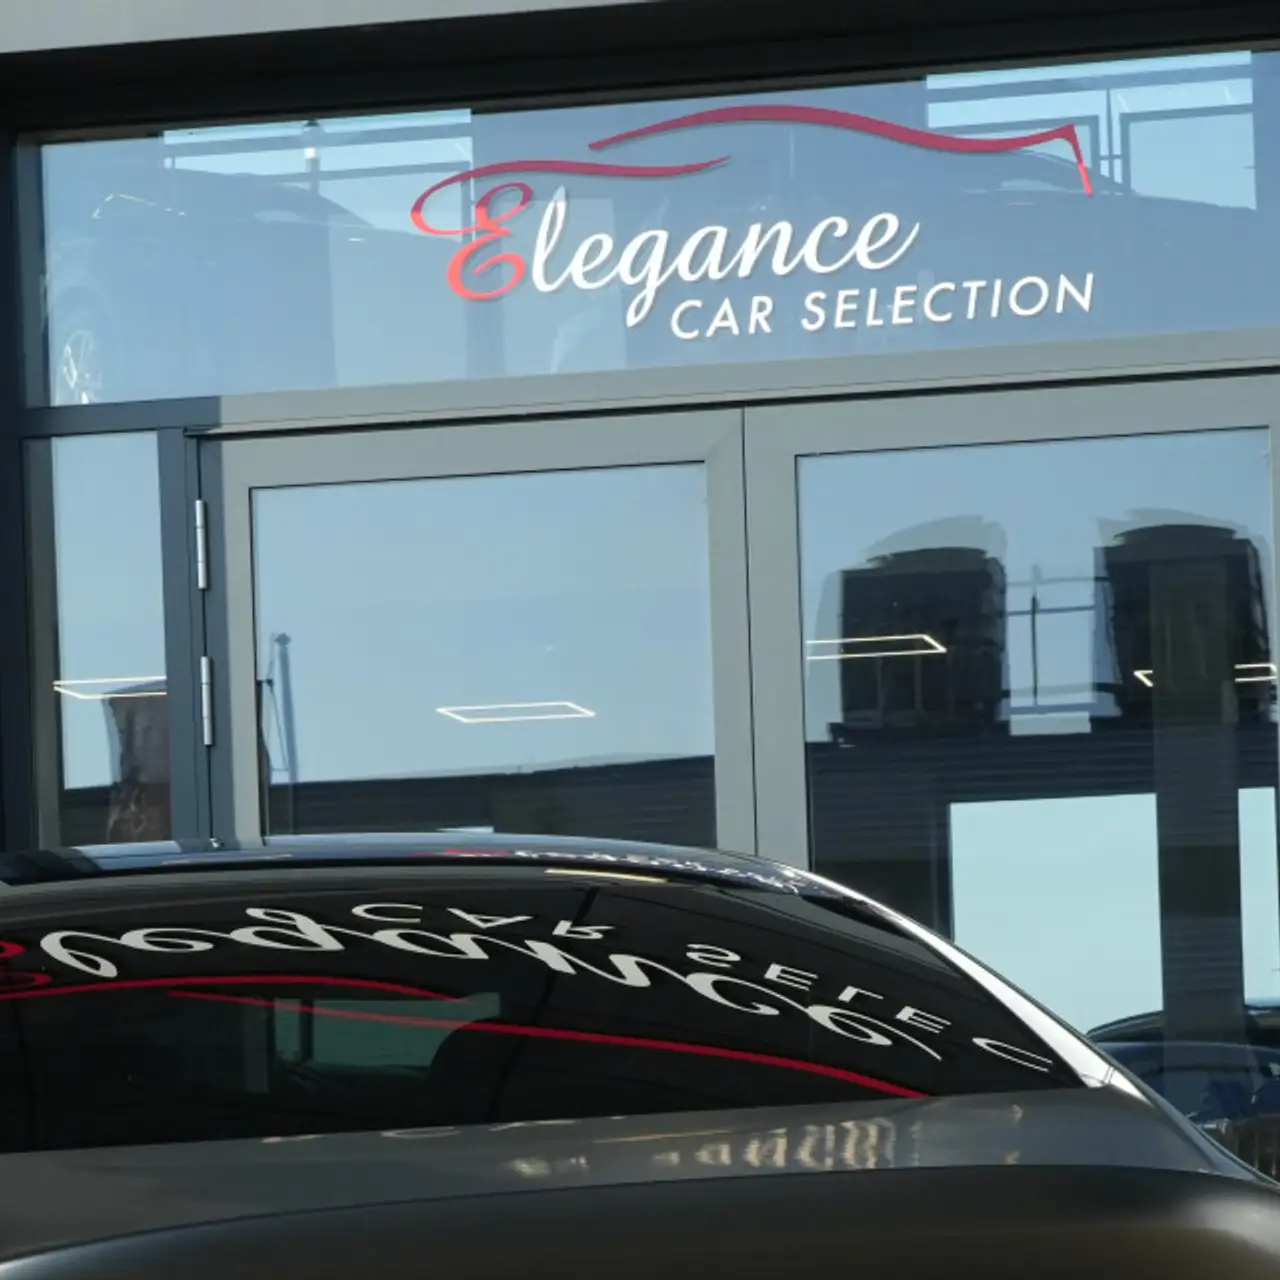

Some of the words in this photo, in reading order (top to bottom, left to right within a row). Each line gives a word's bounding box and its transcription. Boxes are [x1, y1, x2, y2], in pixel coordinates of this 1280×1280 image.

[410, 181, 920, 328] Elegance
[670, 295, 773, 340] CAR
[800, 271, 1095, 334] SELECTION
